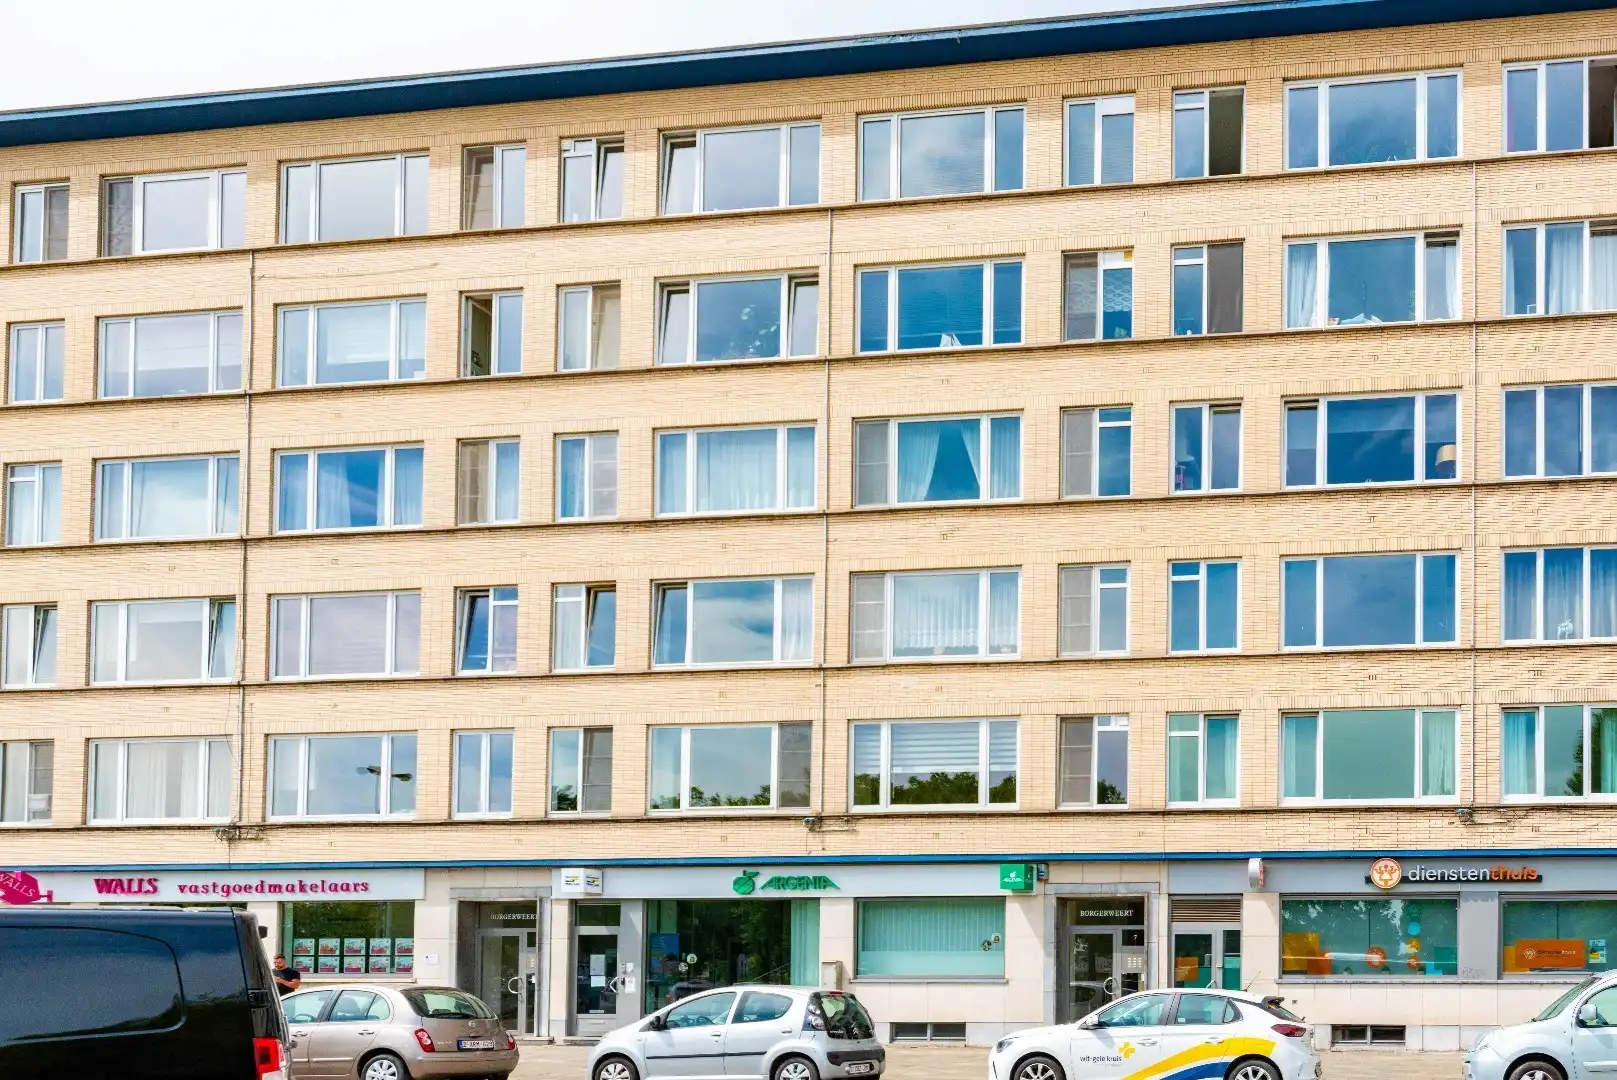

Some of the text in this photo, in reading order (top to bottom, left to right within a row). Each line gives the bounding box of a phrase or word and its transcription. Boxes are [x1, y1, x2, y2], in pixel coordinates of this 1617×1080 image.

[1408, 864, 1538, 881] dienstenthuis
[94, 878, 369, 897] WALLS vastgoedmakelaars
[759, 876, 840, 890] ARGENTA
[1080, 909, 1133, 917] BORGERWEERT
